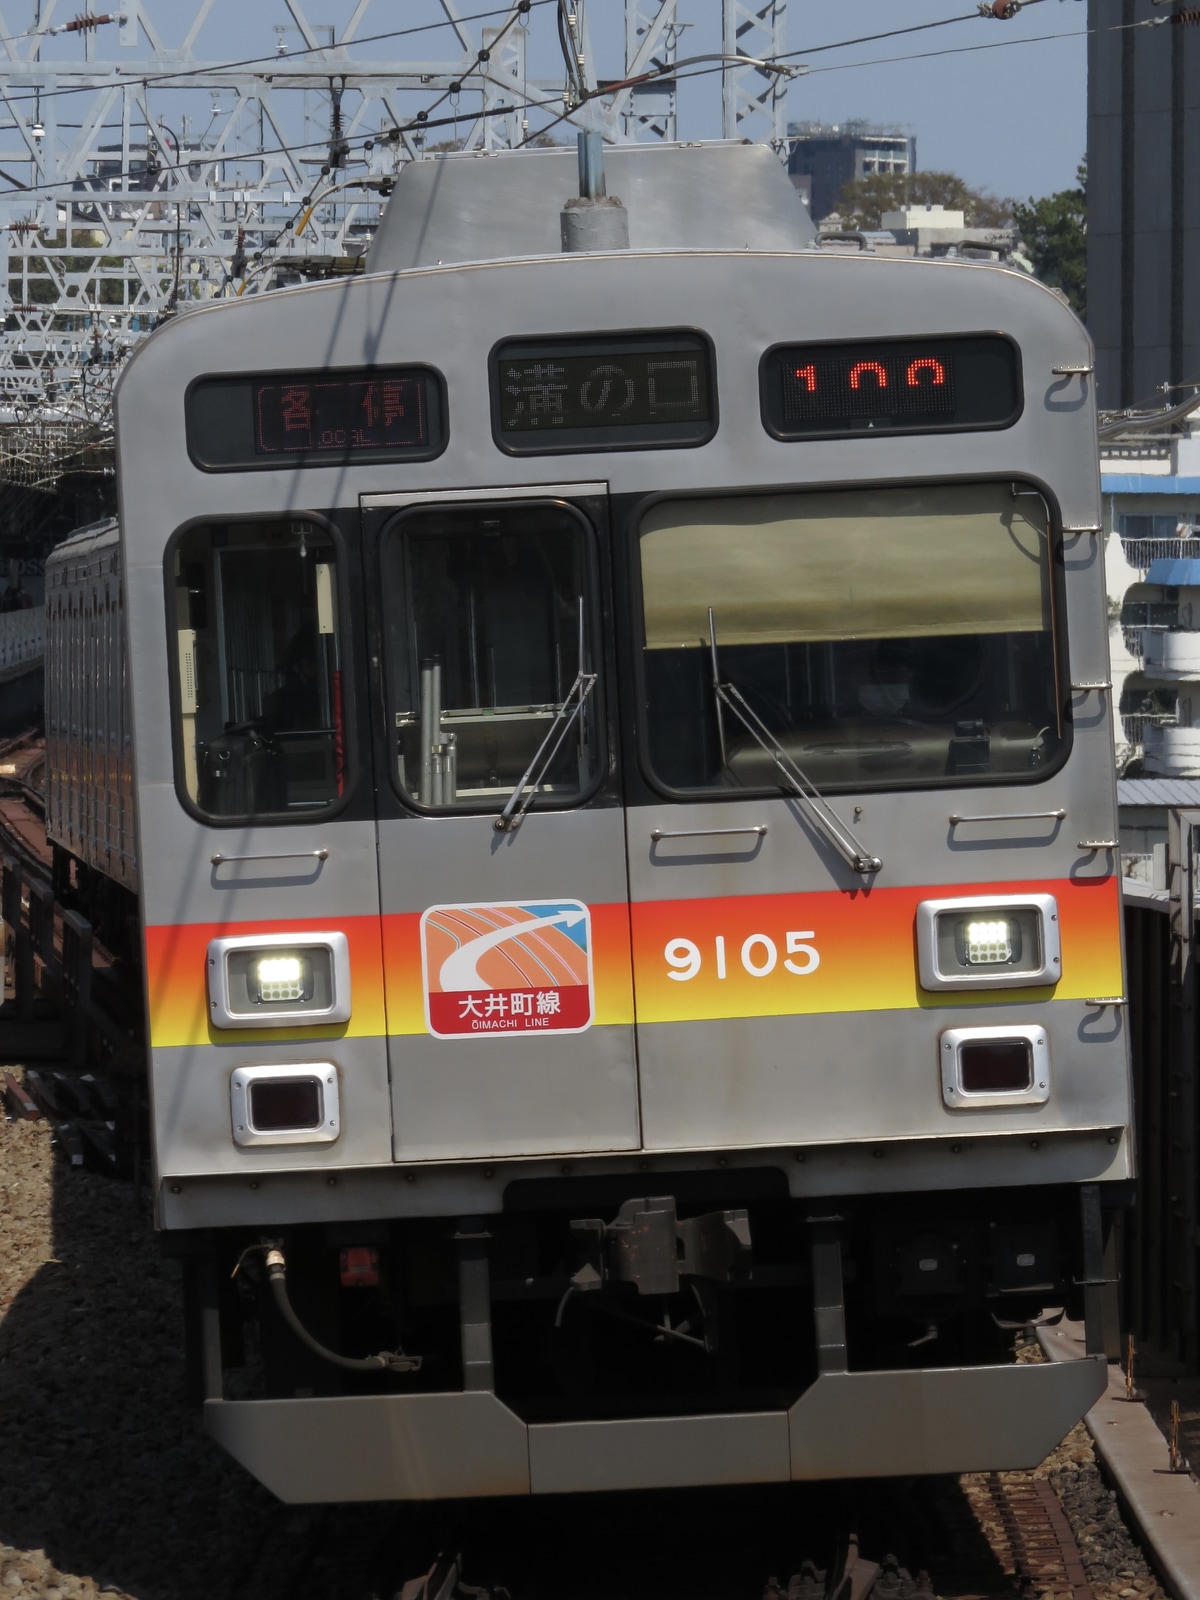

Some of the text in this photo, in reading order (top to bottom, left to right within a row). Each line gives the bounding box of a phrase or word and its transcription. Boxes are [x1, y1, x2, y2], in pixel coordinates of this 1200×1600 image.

[664, 930, 820, 982] 9105
[458, 990, 561, 1019] 大井町線
[525, 1017, 550, 1028] LINE
